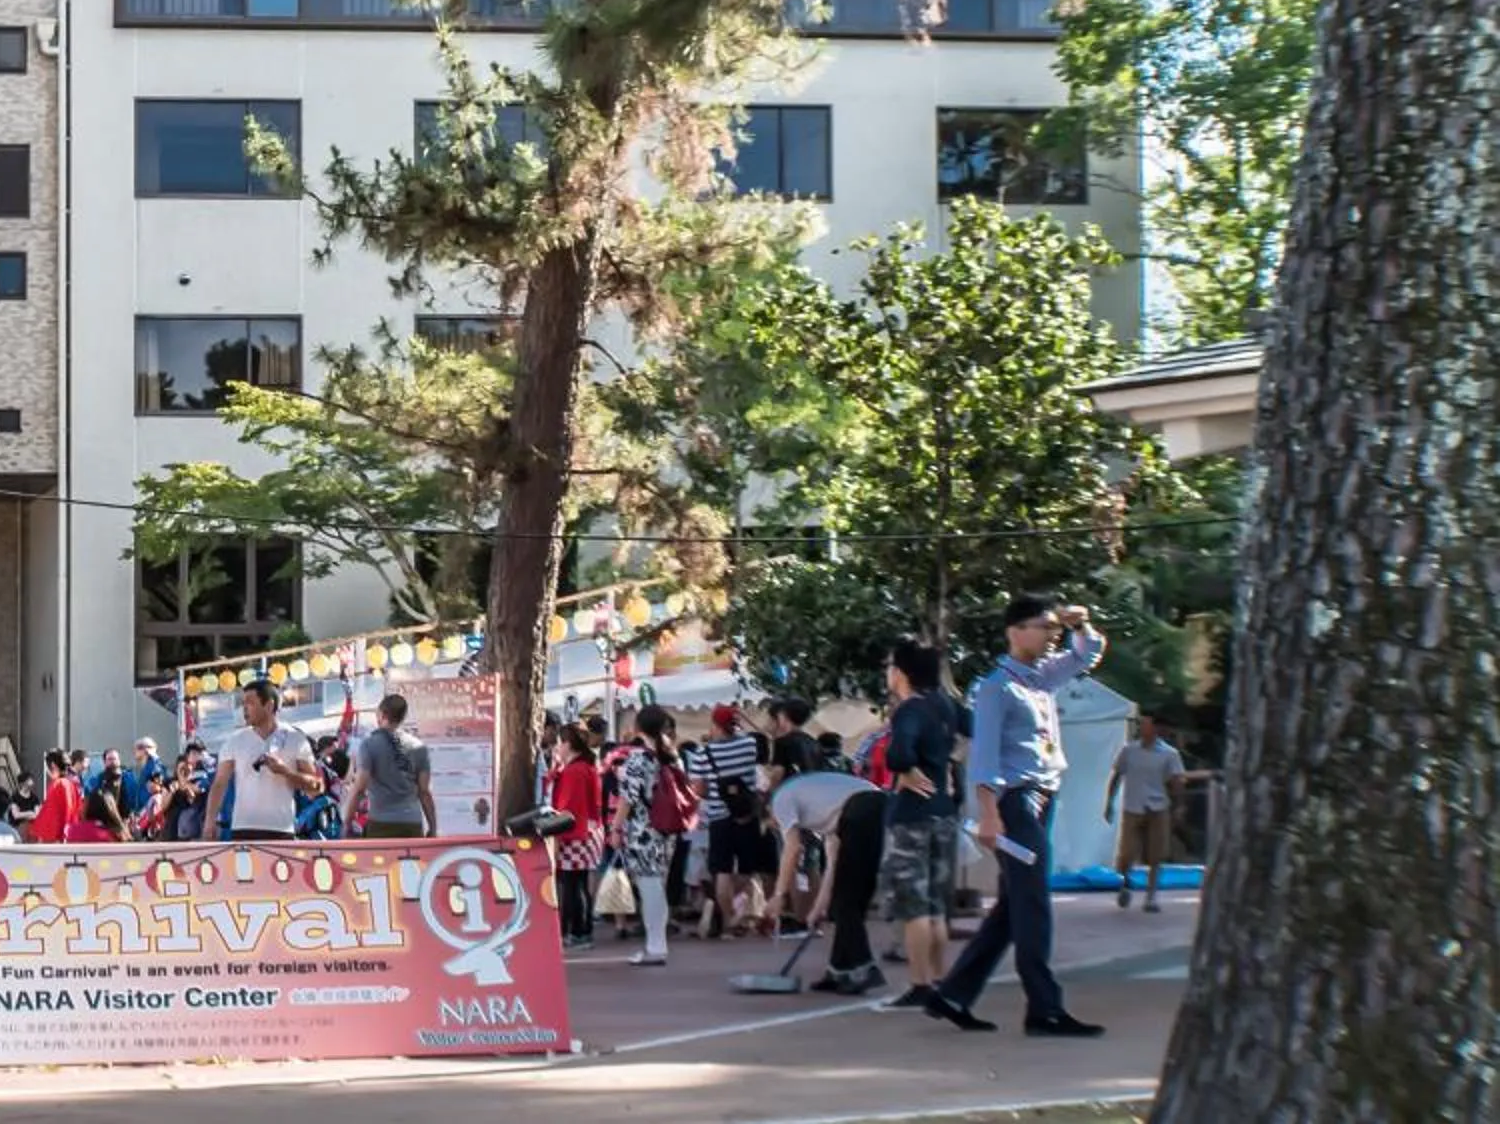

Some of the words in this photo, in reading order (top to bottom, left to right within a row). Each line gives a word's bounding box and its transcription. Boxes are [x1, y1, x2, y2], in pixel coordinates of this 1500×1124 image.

[2, 966, 35, 980] Fun
[40, 965, 120, 980] Carnival"
[126, 964, 141, 978] is
[147, 965, 168, 978] an
[173, 963, 220, 977] event
[227, 962, 253, 976] for
[258, 961, 318, 976] foreign
[323, 959, 394, 974] visitors.
[83, 988, 176, 1010] Visitor
[184, 987, 278, 1008] Center
[439, 994, 533, 1026] NARA
